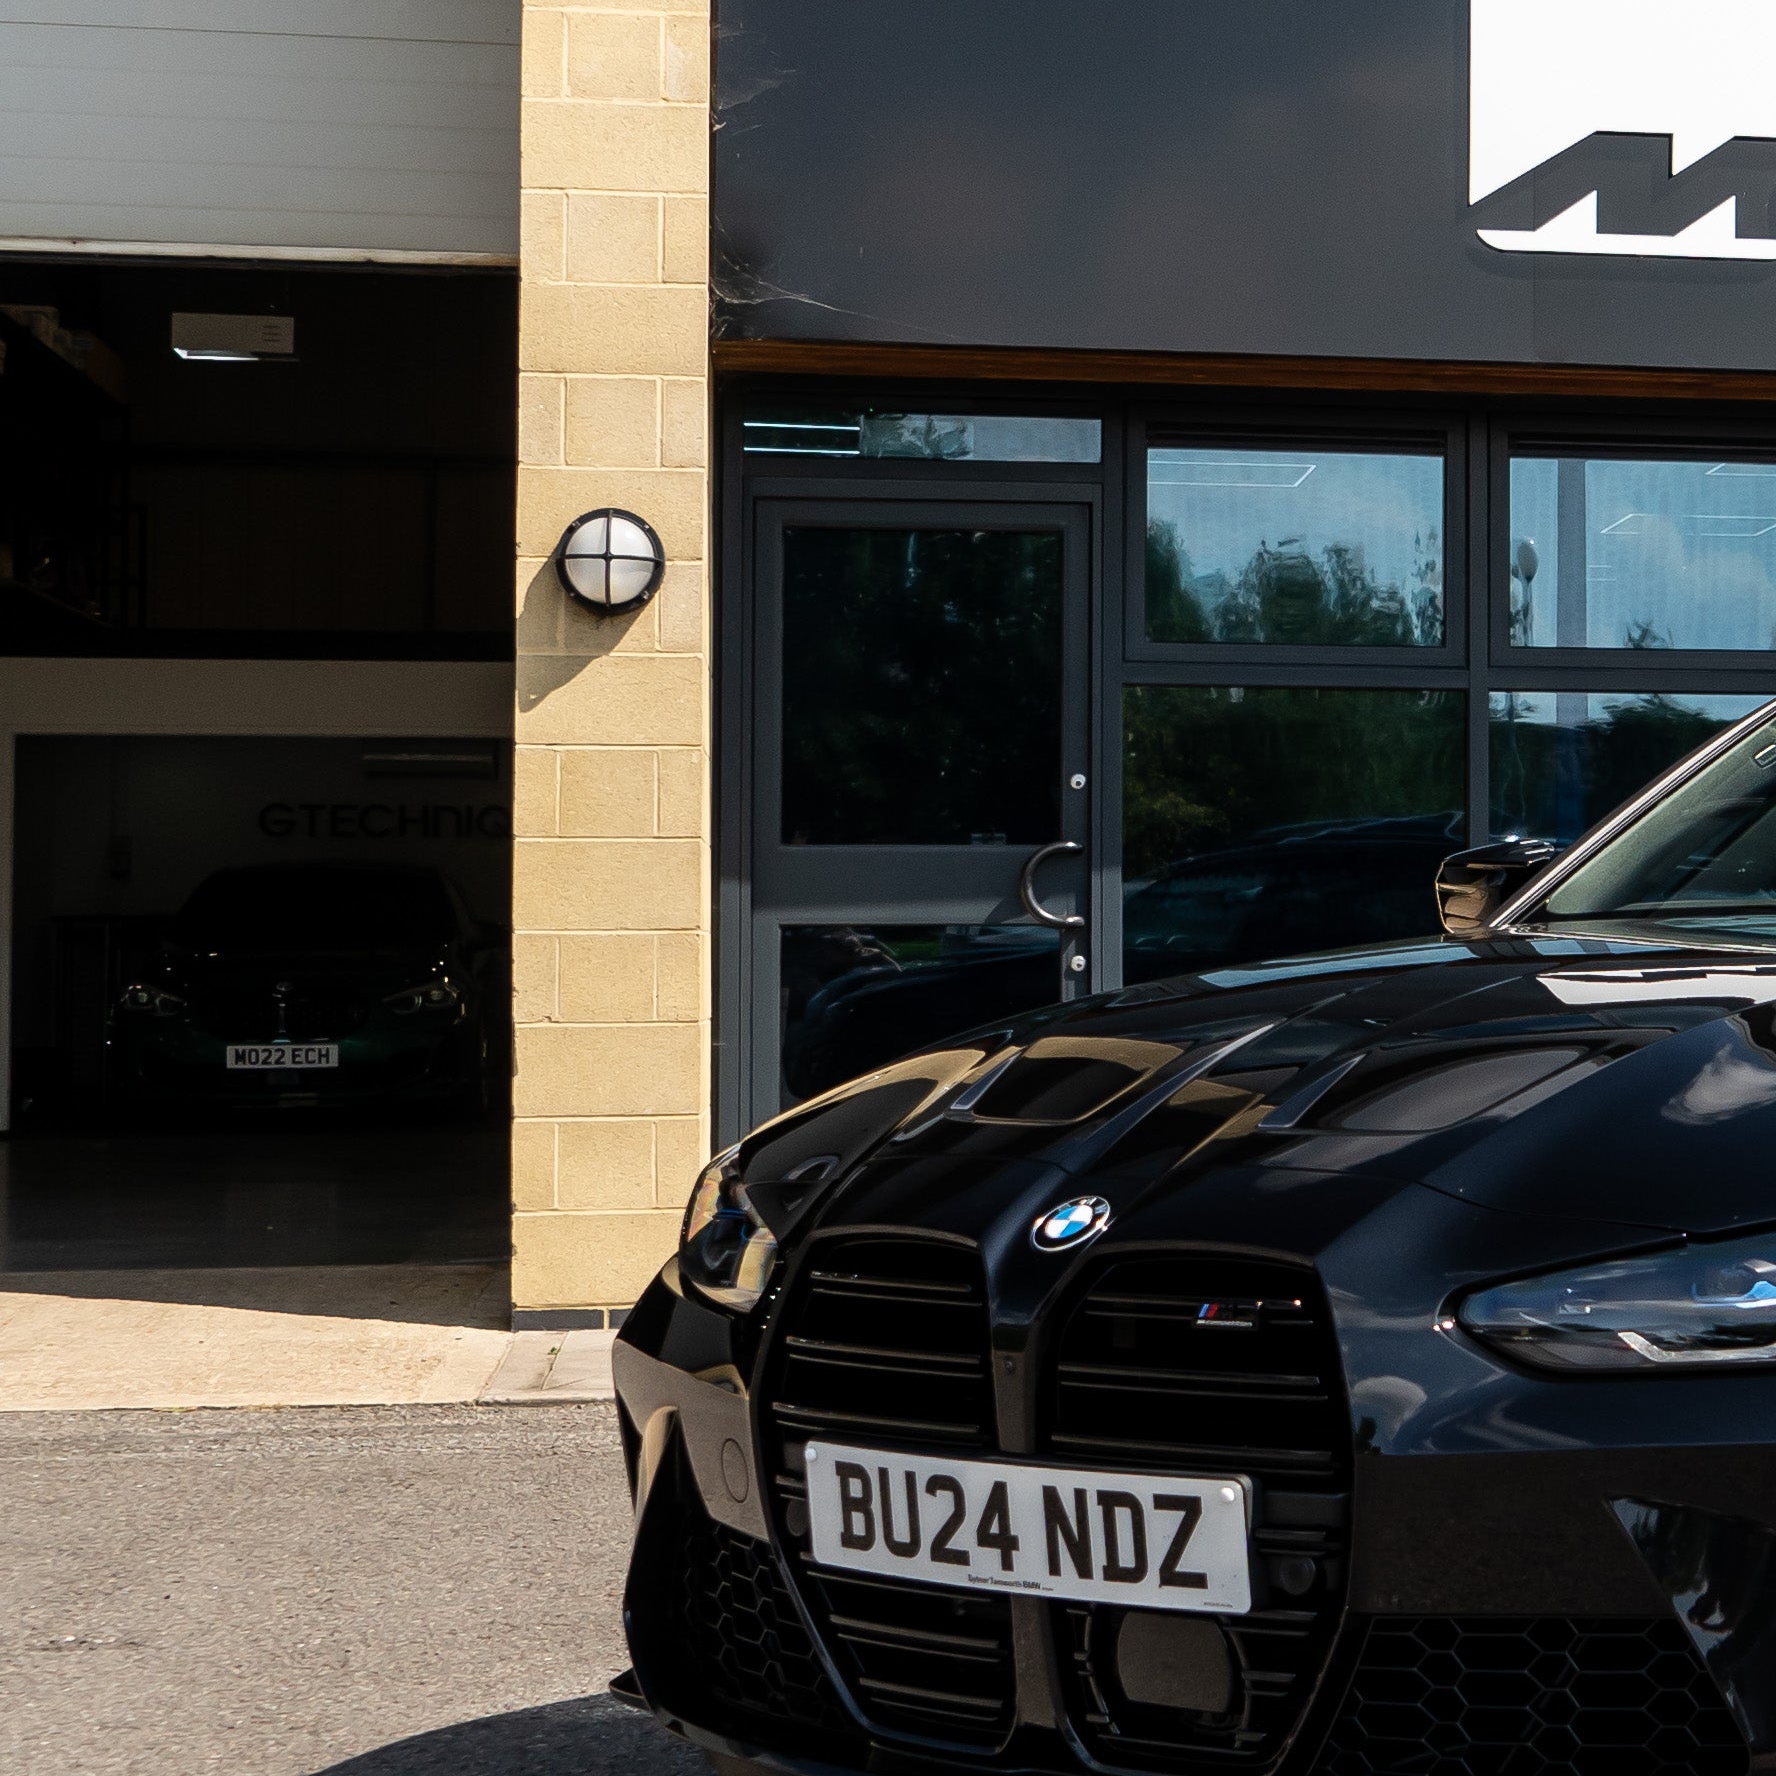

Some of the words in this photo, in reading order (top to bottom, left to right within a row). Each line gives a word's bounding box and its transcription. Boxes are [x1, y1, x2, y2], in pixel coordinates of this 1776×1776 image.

[259, 802, 513, 839] GTECHNIQ
[234, 1047, 286, 1066] MO22
[291, 1046, 330, 1065] ECH
[835, 1460, 1020, 1572] BU24
[1041, 1484, 1209, 1590] NDZ
